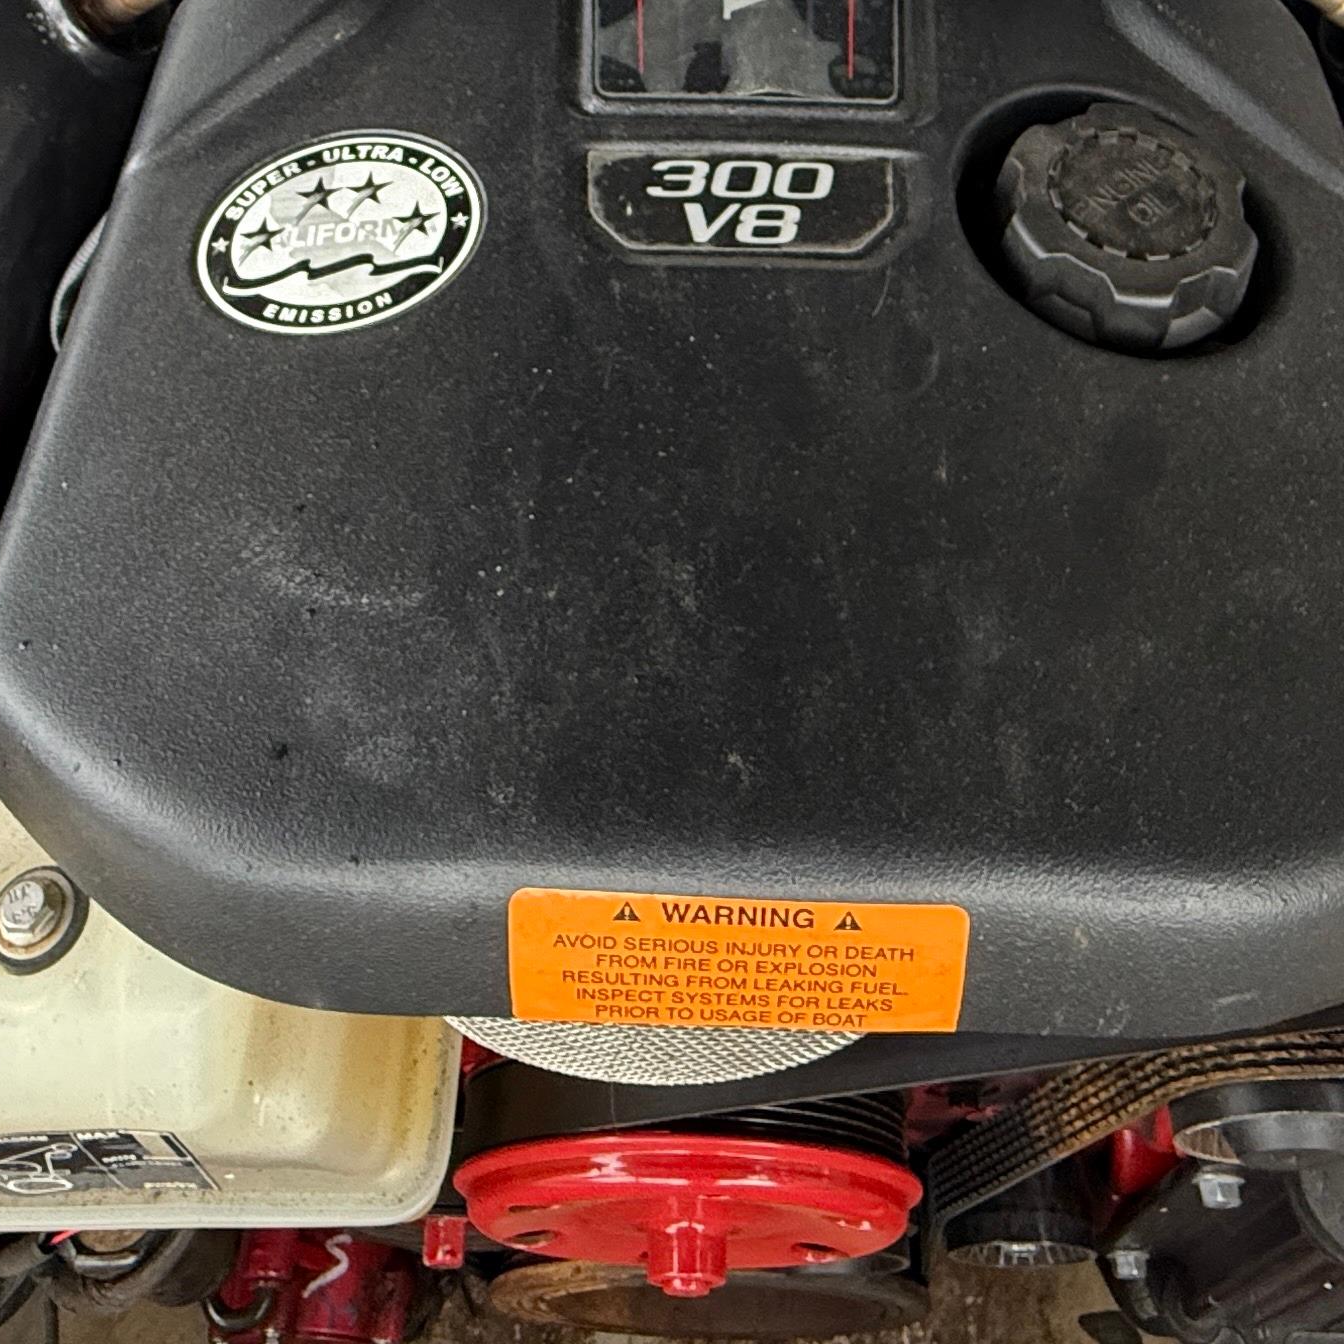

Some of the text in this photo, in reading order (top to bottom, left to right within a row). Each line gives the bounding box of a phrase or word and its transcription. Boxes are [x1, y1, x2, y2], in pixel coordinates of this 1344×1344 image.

[224, 144, 465, 221] SUPER ULTRA LOW
[645, 159, 834, 200] 300
[681, 203, 801, 245] V8
[261, 292, 393, 324] EMISSION
[661, 902, 815, 929] WARNING
[553, 933, 915, 962] AVOID SERIOUS INJURY OR DEATH
[596, 954, 878, 978] FROM FIRE OR EXPLOSION
[562, 969, 909, 996] RESULTING FROM LEAKING FUEL.
[576, 987, 893, 1012] INSPECT SYSTEMS FOR LEAKS
[595, 1004, 868, 1028] PRIOR TO USAGE OF BOAT
